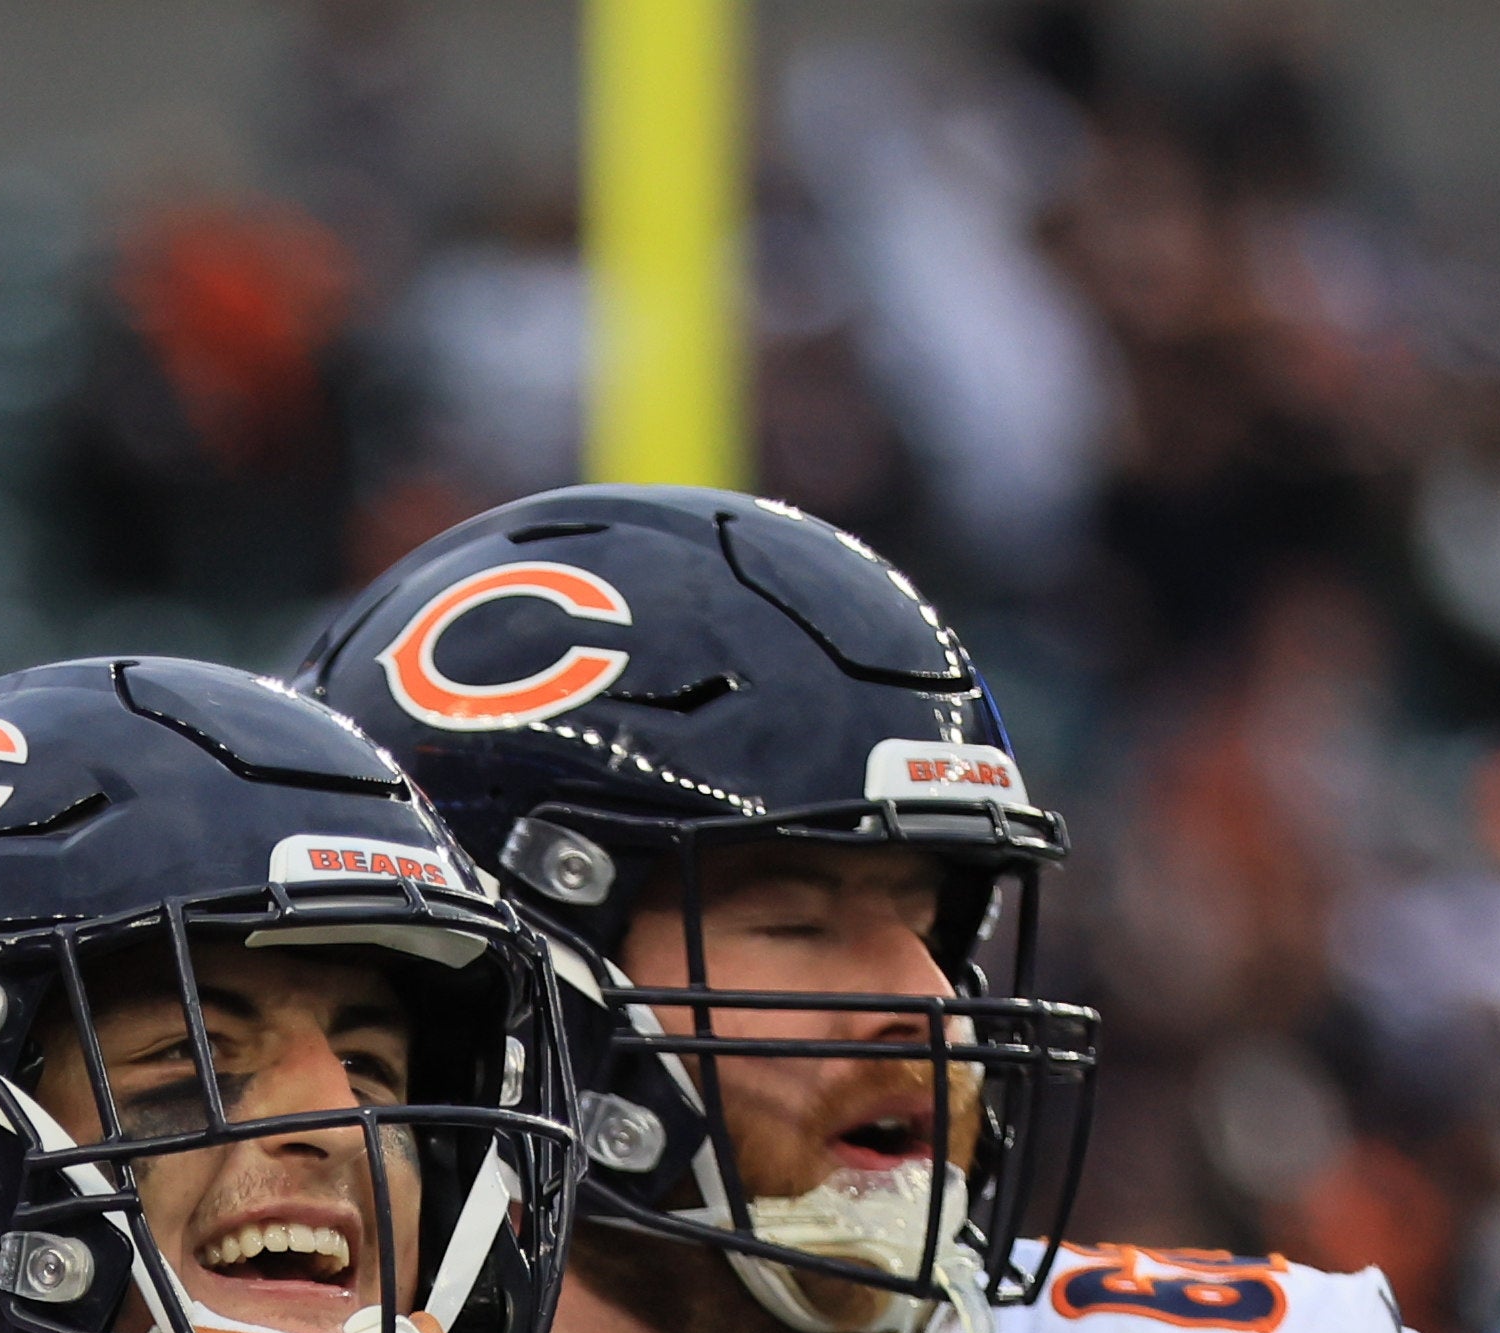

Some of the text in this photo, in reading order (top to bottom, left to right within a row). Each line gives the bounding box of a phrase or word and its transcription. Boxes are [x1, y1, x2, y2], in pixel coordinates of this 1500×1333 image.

[376, 560, 632, 731] C
[907, 759, 1012, 788] BEARS
[308, 848, 448, 887] BEARS
